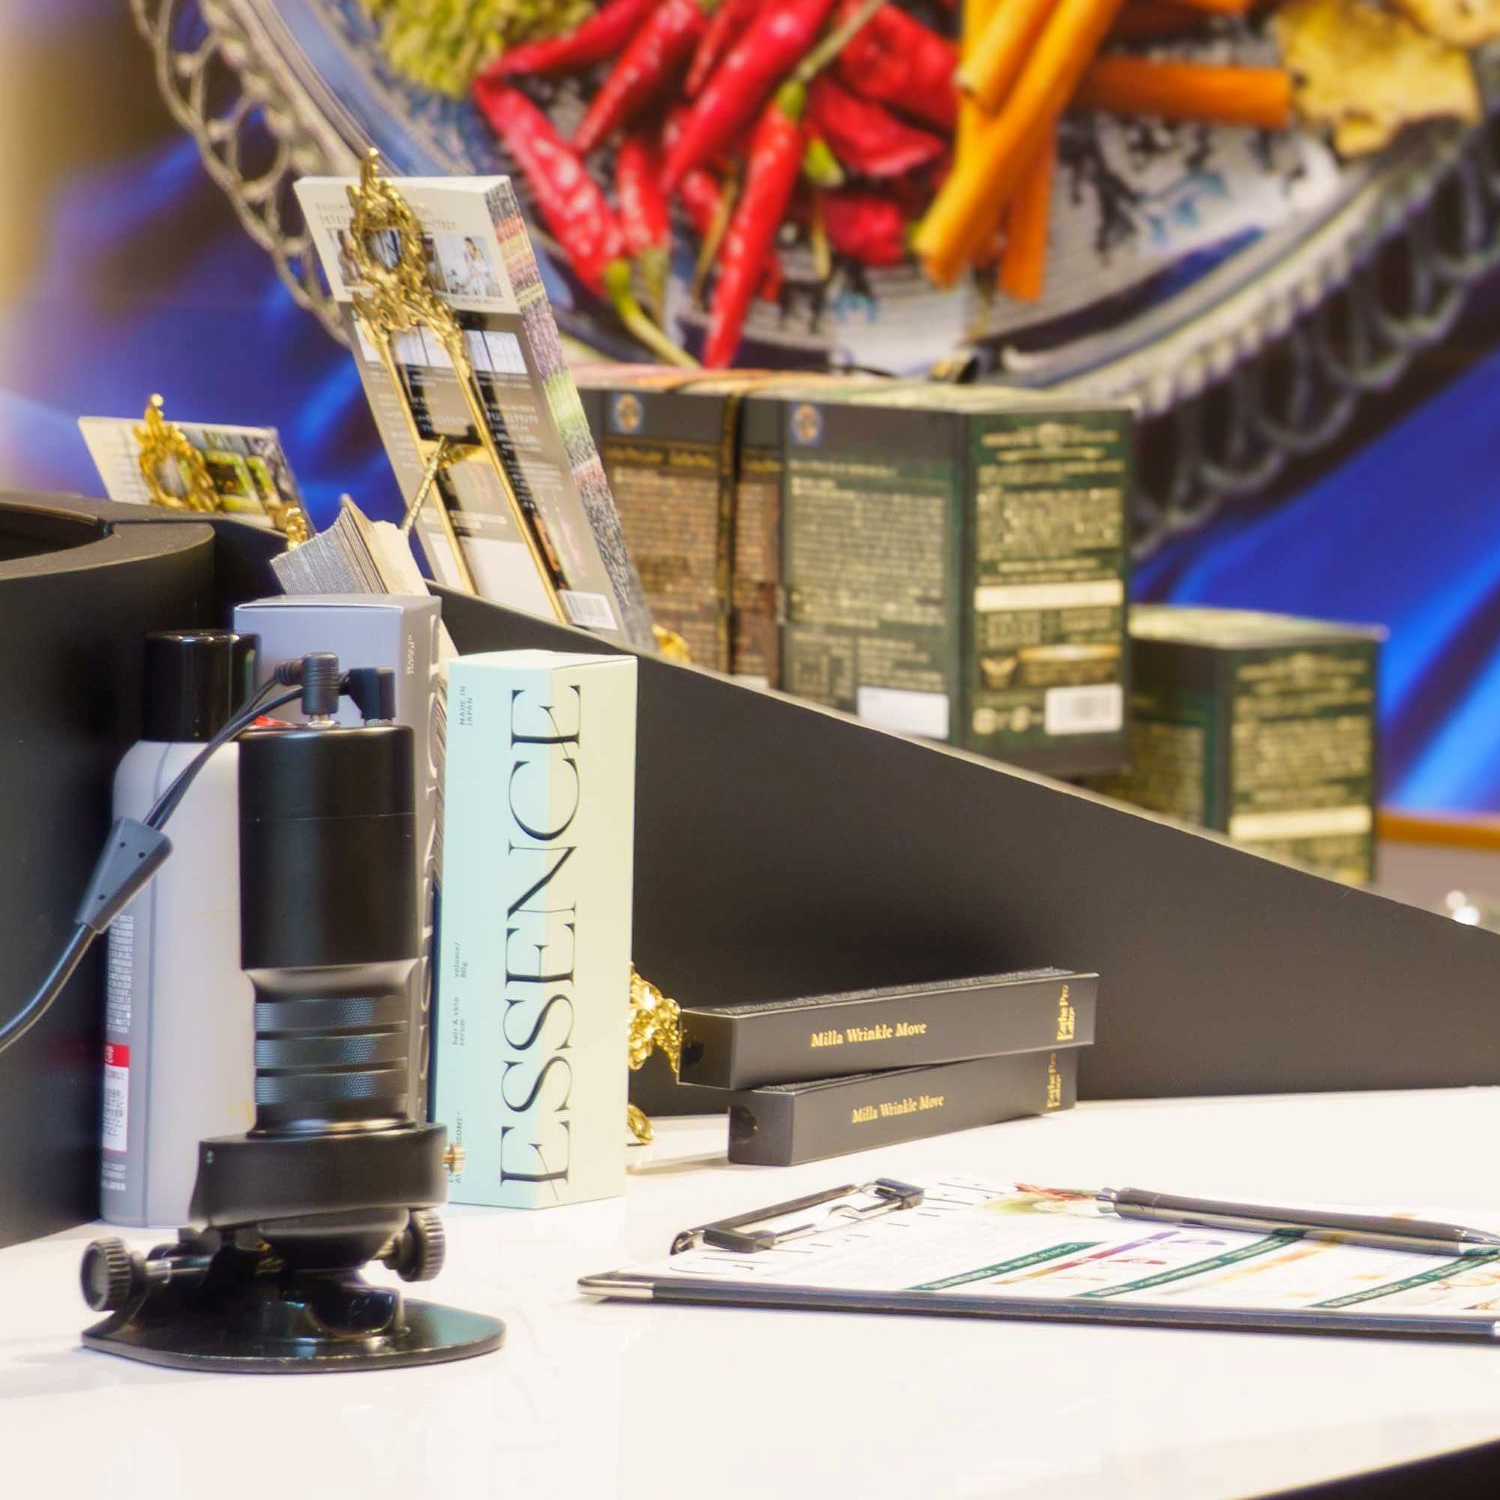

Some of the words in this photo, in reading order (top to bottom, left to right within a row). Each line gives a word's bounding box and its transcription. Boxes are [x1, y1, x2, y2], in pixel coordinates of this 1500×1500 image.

[500, 683, 581, 1200] ESSENCE
[810, 1031, 844, 1048] Milla
[846, 1023, 894, 1044] Wrinkle
[895, 1021, 928, 1038] Move
[851, 1107, 878, 1124] Milla
[879, 1097, 917, 1119] Wrinkle
[918, 1093, 945, 1111] Move
